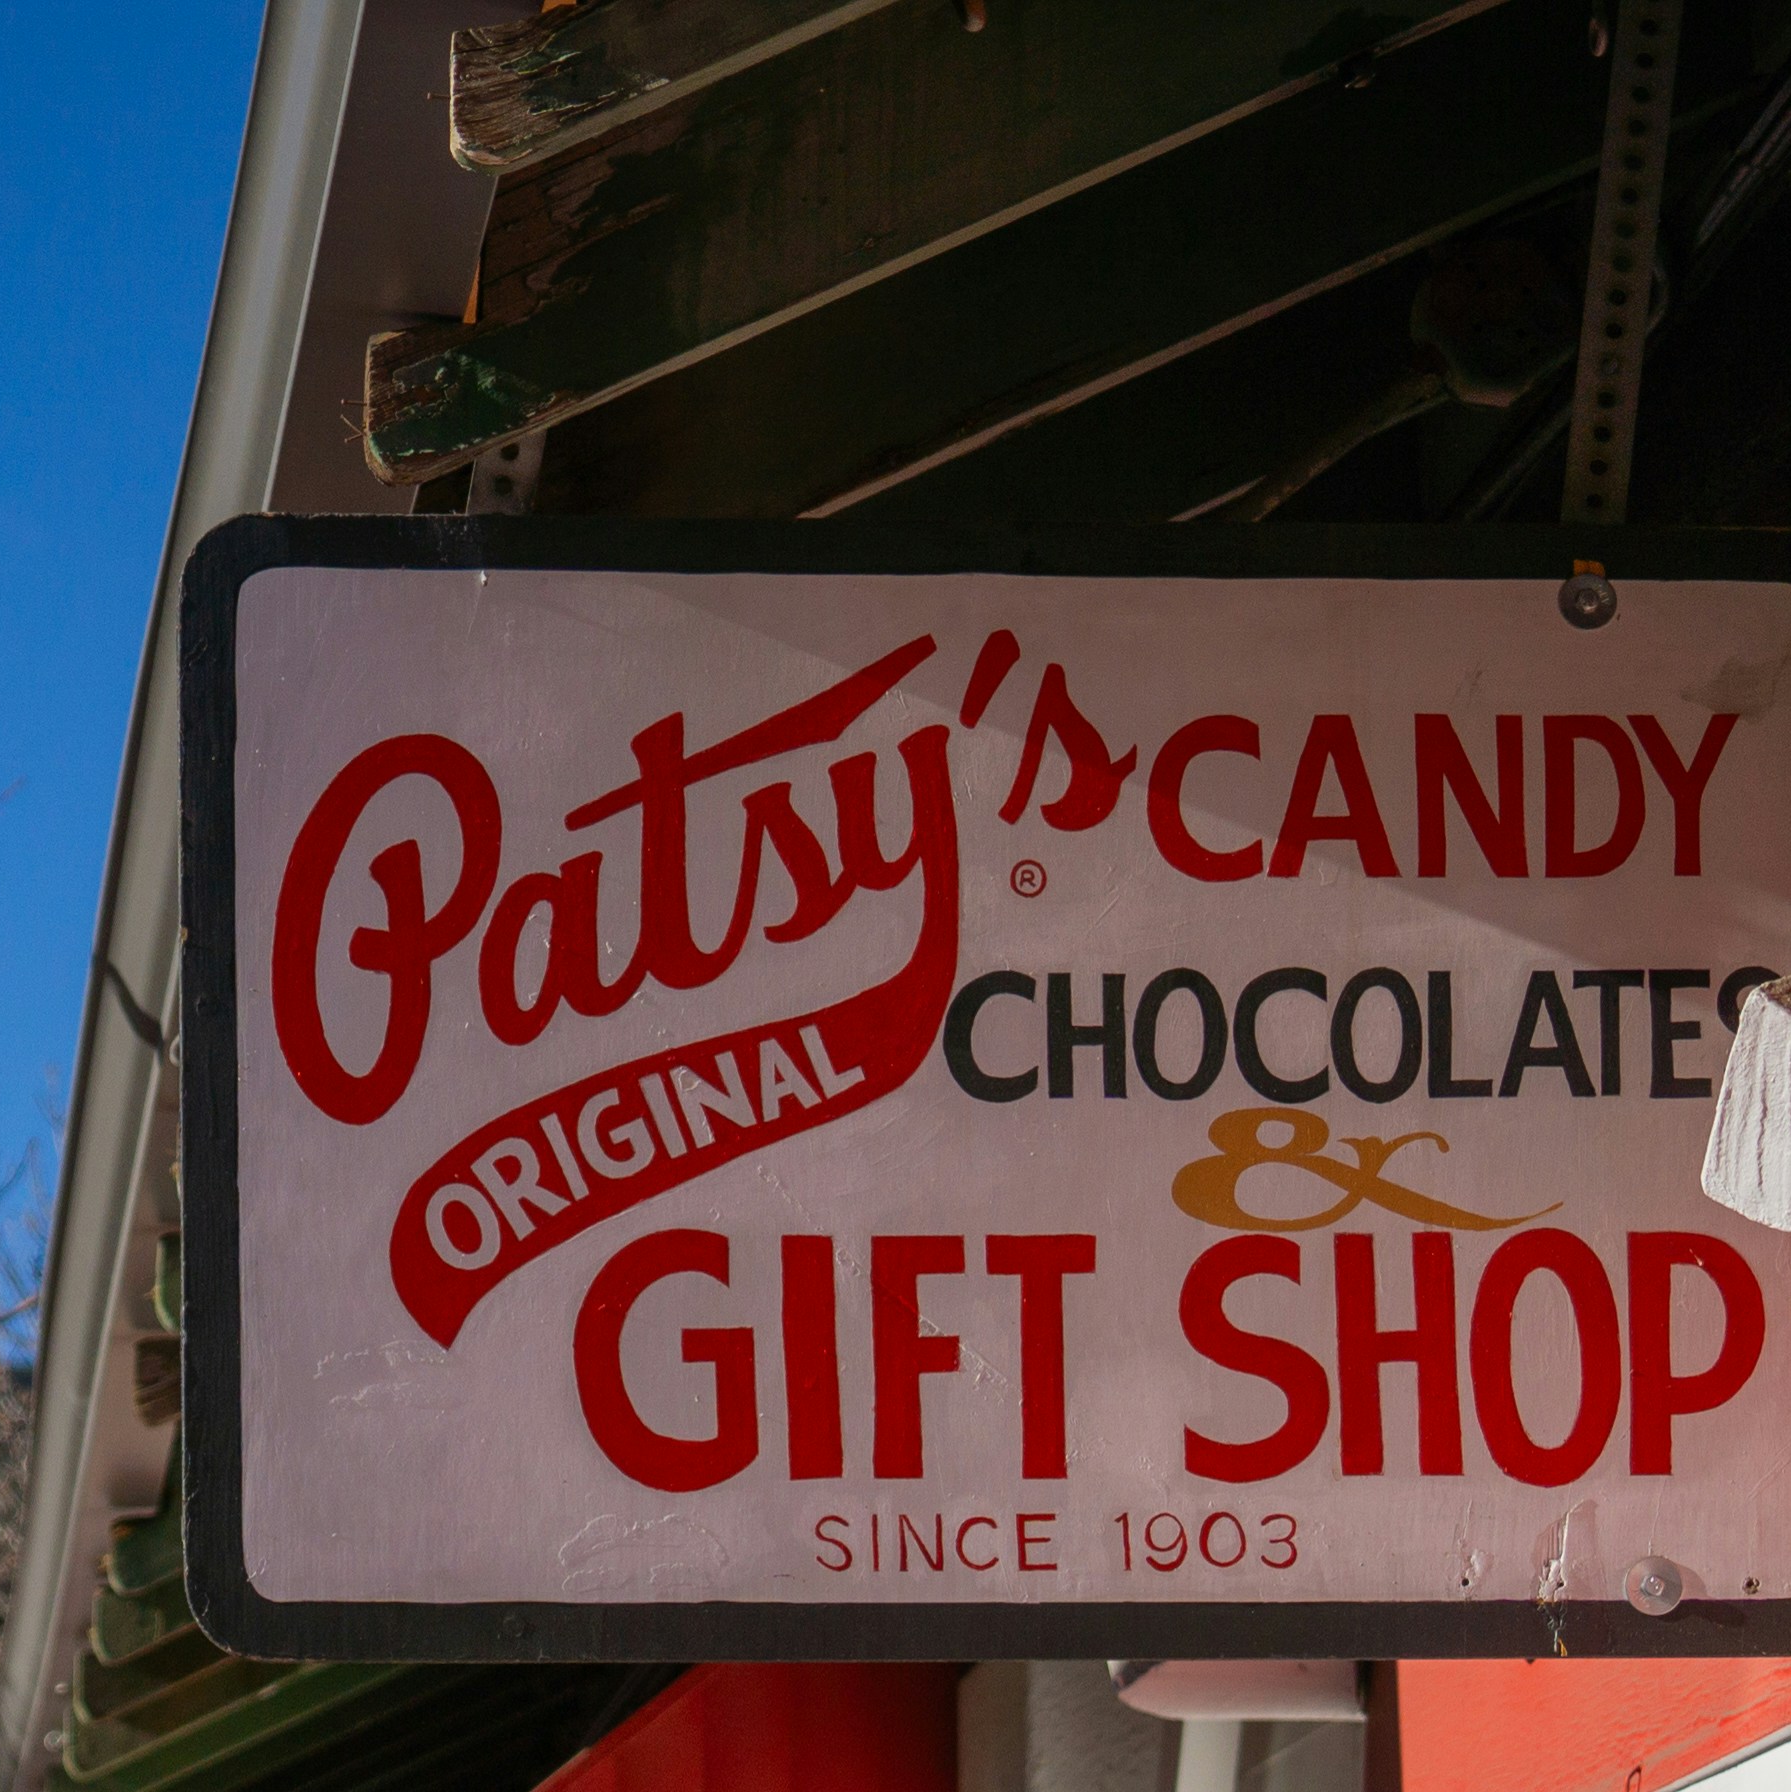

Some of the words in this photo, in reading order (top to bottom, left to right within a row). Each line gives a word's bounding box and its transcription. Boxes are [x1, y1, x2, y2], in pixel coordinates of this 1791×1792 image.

[272, 629, 1137, 1126] Patsy's
[1146, 712, 1738, 883] CANDY
[425, 1024, 867, 1270] ORIGINAL
[1171, 1106, 1564, 1233] &
[572, 1227, 1097, 1494] GIFT
[1178, 1227, 1766, 1489] SHOP
[814, 1512, 1058, 1573] SINCE
[1116, 1510, 1300, 1572] 1903
